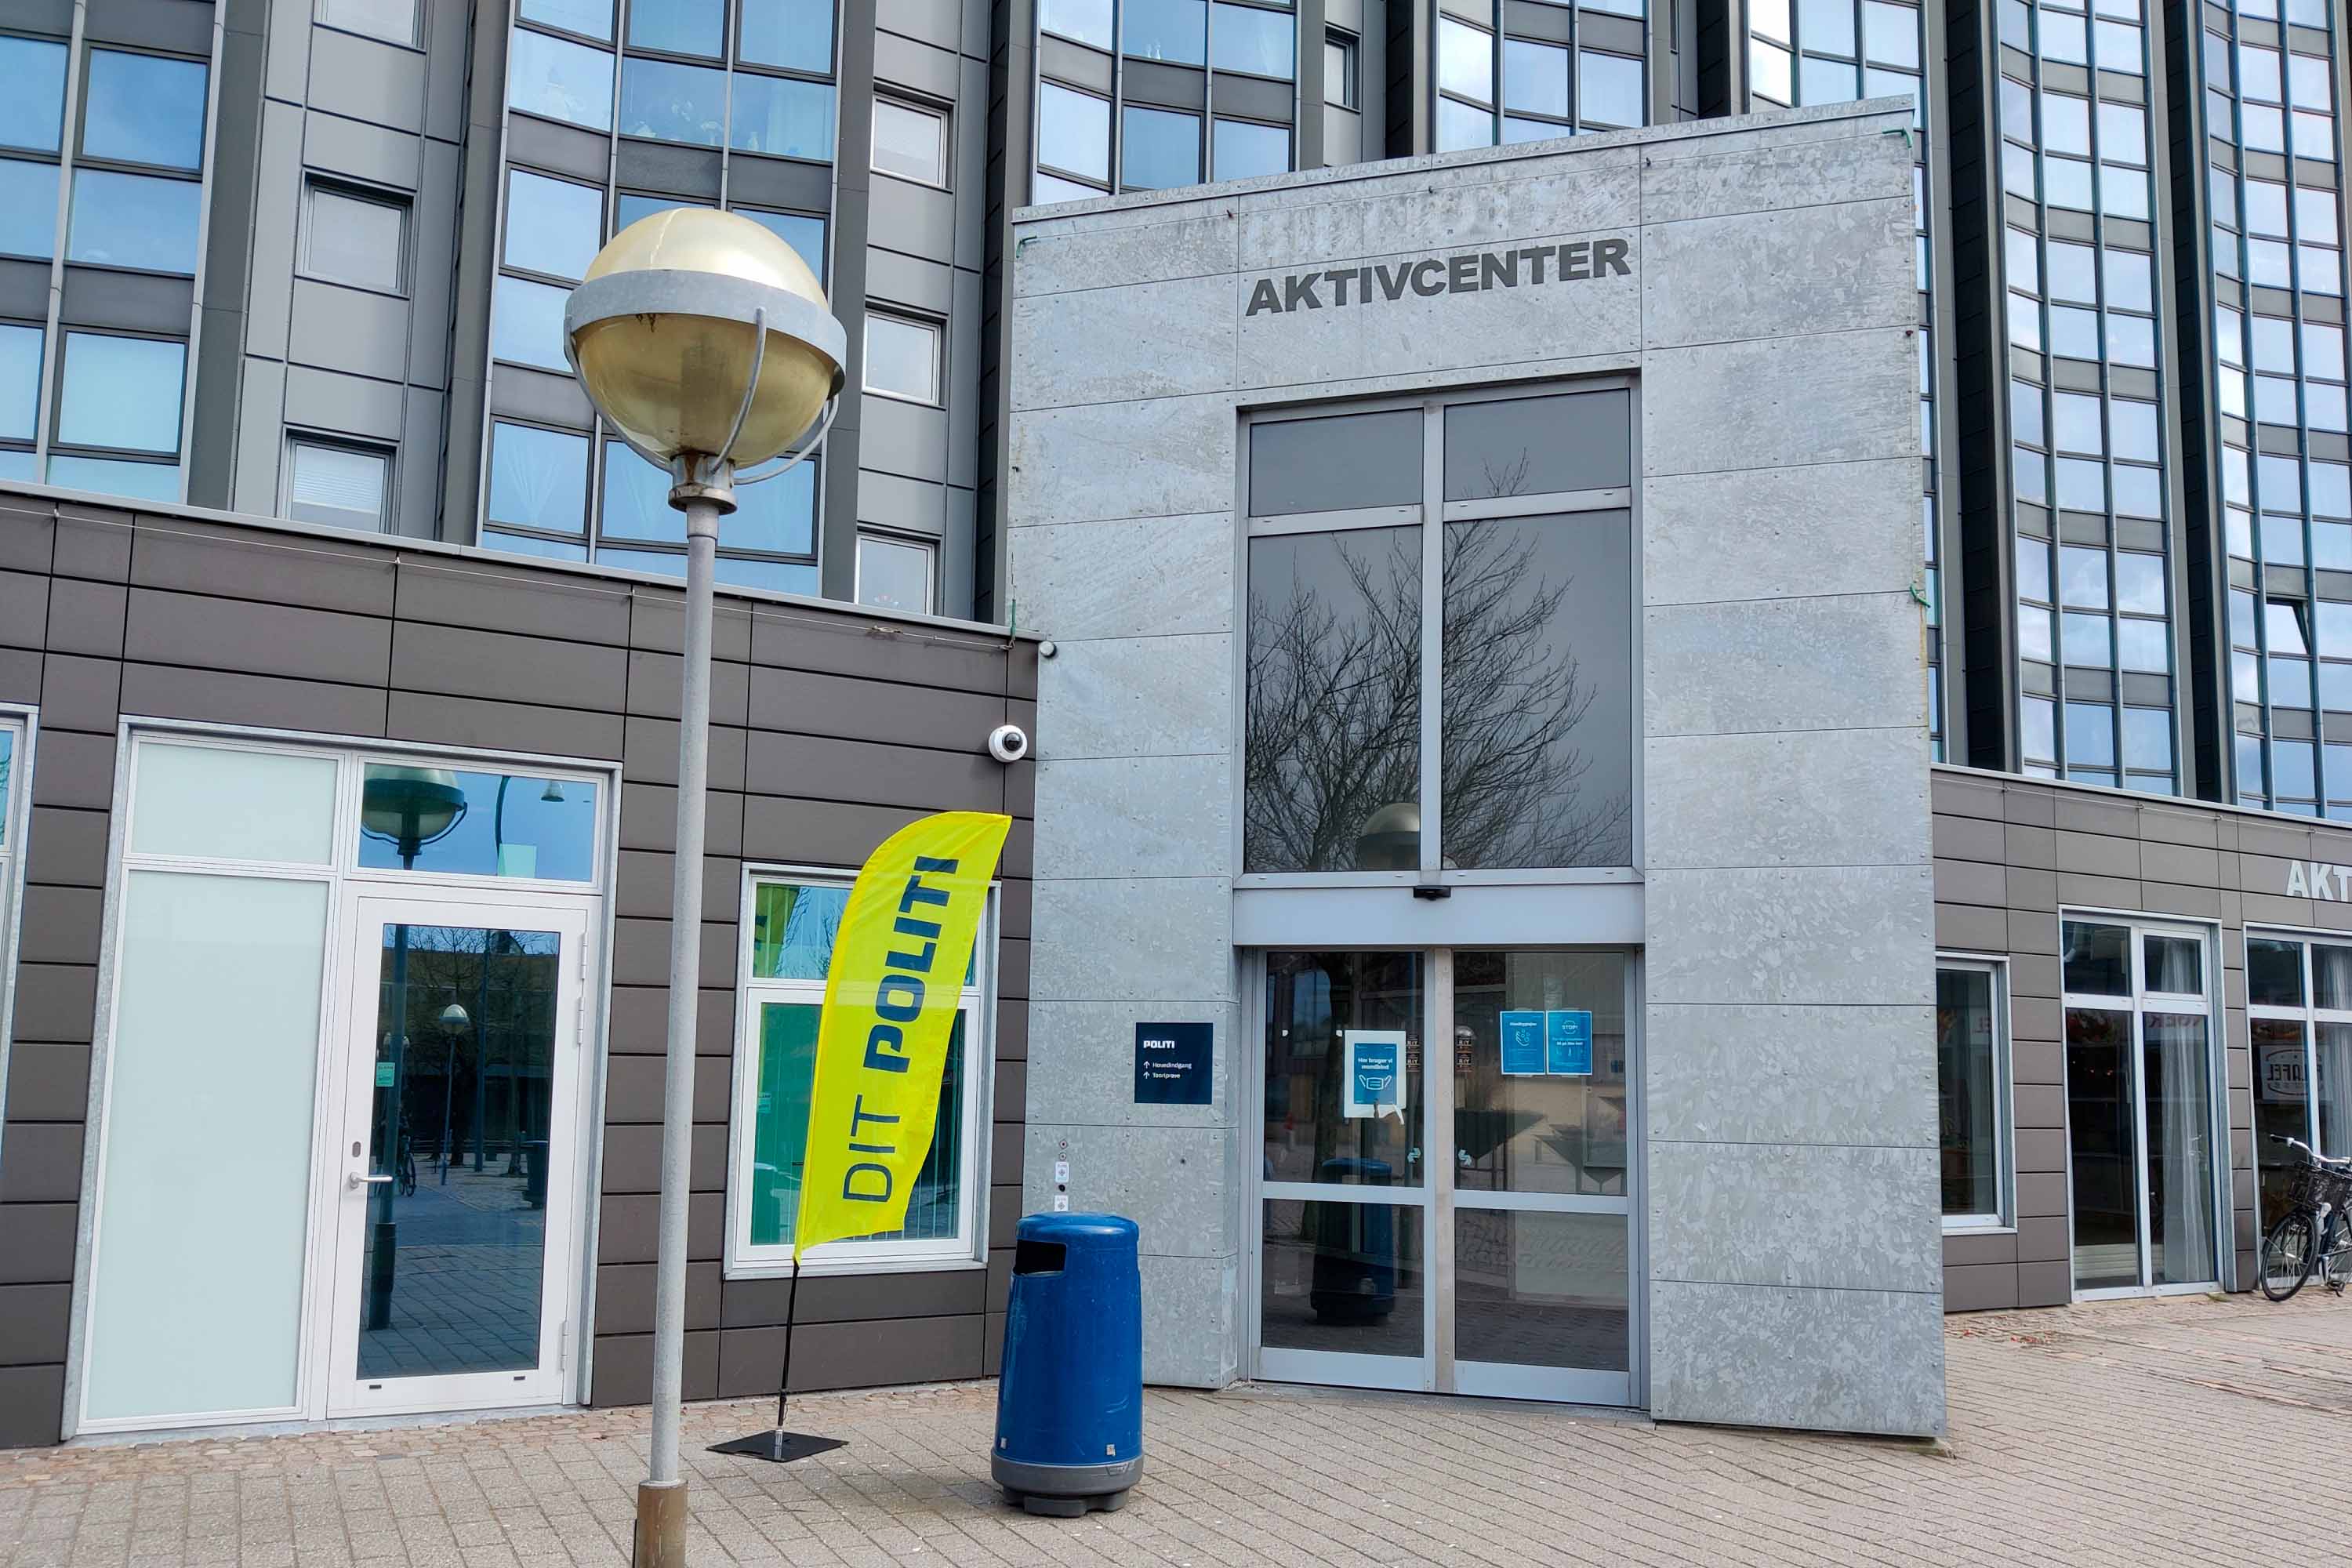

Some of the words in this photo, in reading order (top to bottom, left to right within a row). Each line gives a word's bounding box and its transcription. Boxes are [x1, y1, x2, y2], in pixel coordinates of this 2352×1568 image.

[1246, 238, 1632, 317] AKTIVCENTER
[2286, 860, 2352, 902] AKT
[863, 856, 960, 1073] POLITI
[1143, 1040, 1174, 1049] POLITI
[843, 1094, 900, 1203] DIT
